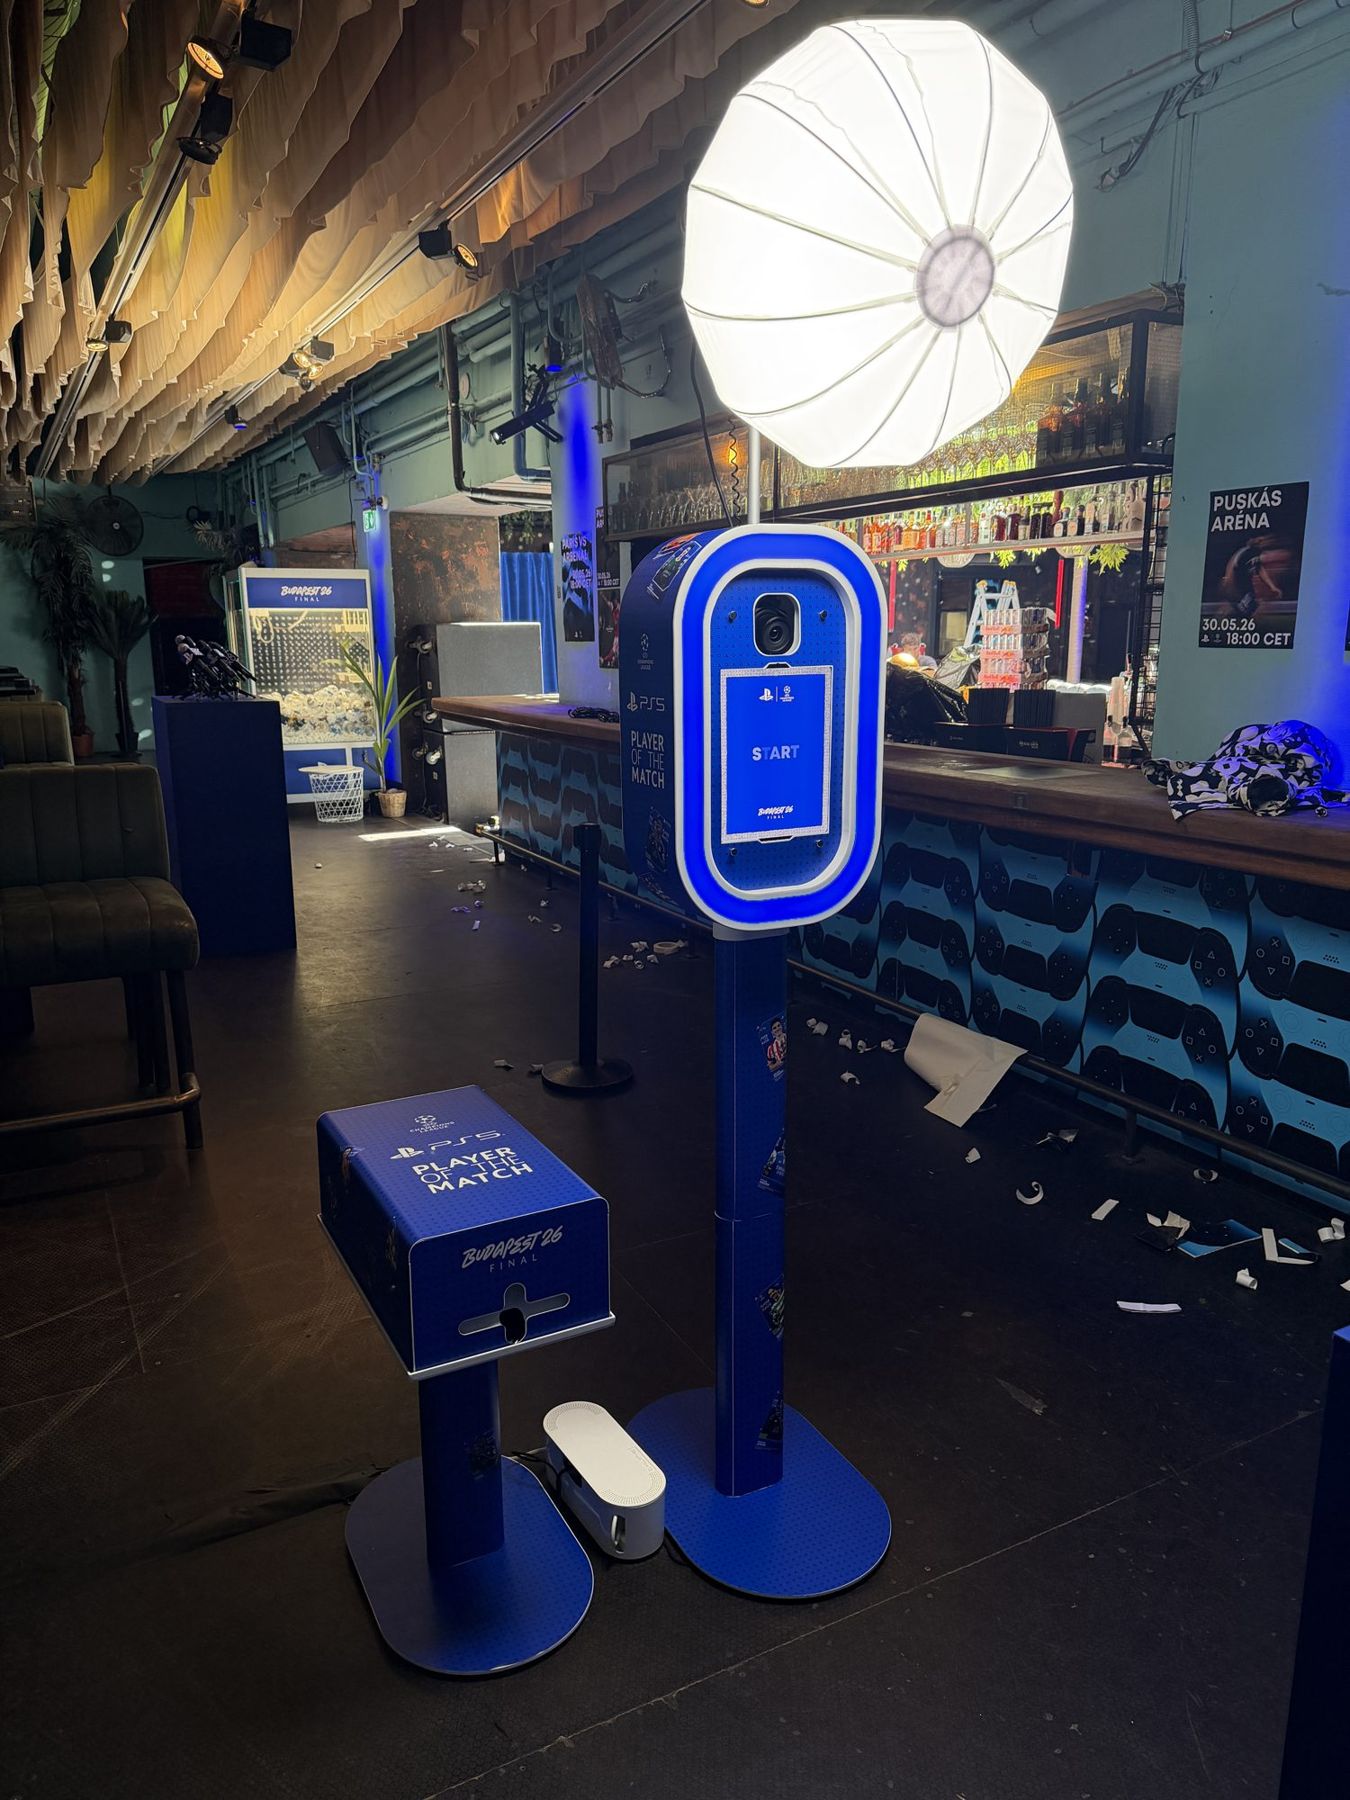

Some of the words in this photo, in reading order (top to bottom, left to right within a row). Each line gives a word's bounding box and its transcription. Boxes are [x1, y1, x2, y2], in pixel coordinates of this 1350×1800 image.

[1213, 487, 1282, 512] PUSKÁS
[1211, 510, 1270, 532] ARÉNA
[280, 585, 320, 596] BUDAPEST
[1202, 618, 1255, 631] 30.05.26
[1226, 632, 1260, 645] 18:00
[1263, 632, 1291, 645] CET
[639, 695, 665, 712] PS5
[631, 730, 665, 752] PLAYER
[631, 748, 642, 765] OF
[649, 751, 665, 771] THE
[752, 745, 799, 761] START
[631, 767, 665, 789] MATCH
[428, 1130, 501, 1151] PS5
[412, 1146, 518, 1176] PLAYER
[420, 1168, 453, 1184] OF
[470, 1156, 526, 1172] THE
[427, 1163, 534, 1194] MATCH
[461, 1230, 543, 1269] BUDAPEST
[540, 1225, 564, 1247] 26
[489, 1254, 537, 1273] FINAL
